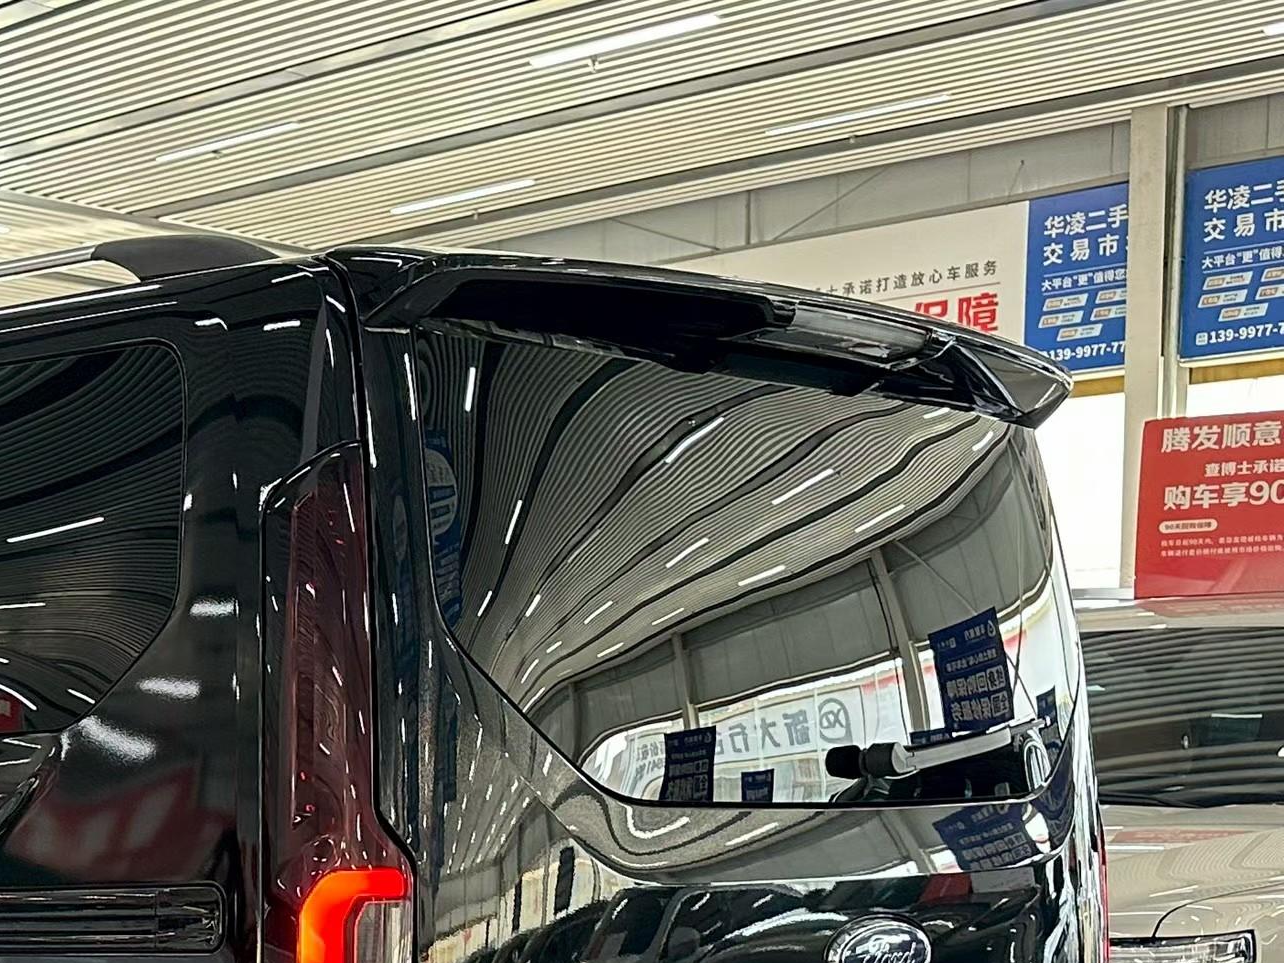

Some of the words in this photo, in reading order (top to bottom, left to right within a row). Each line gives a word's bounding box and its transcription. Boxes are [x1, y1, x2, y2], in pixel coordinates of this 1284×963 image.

[1043, 233, 1128, 266] 交易市
[817, 260, 997, 296] 士承诺打造放心车服务
[1161, 421, 1282, 453] 腾发顺意
